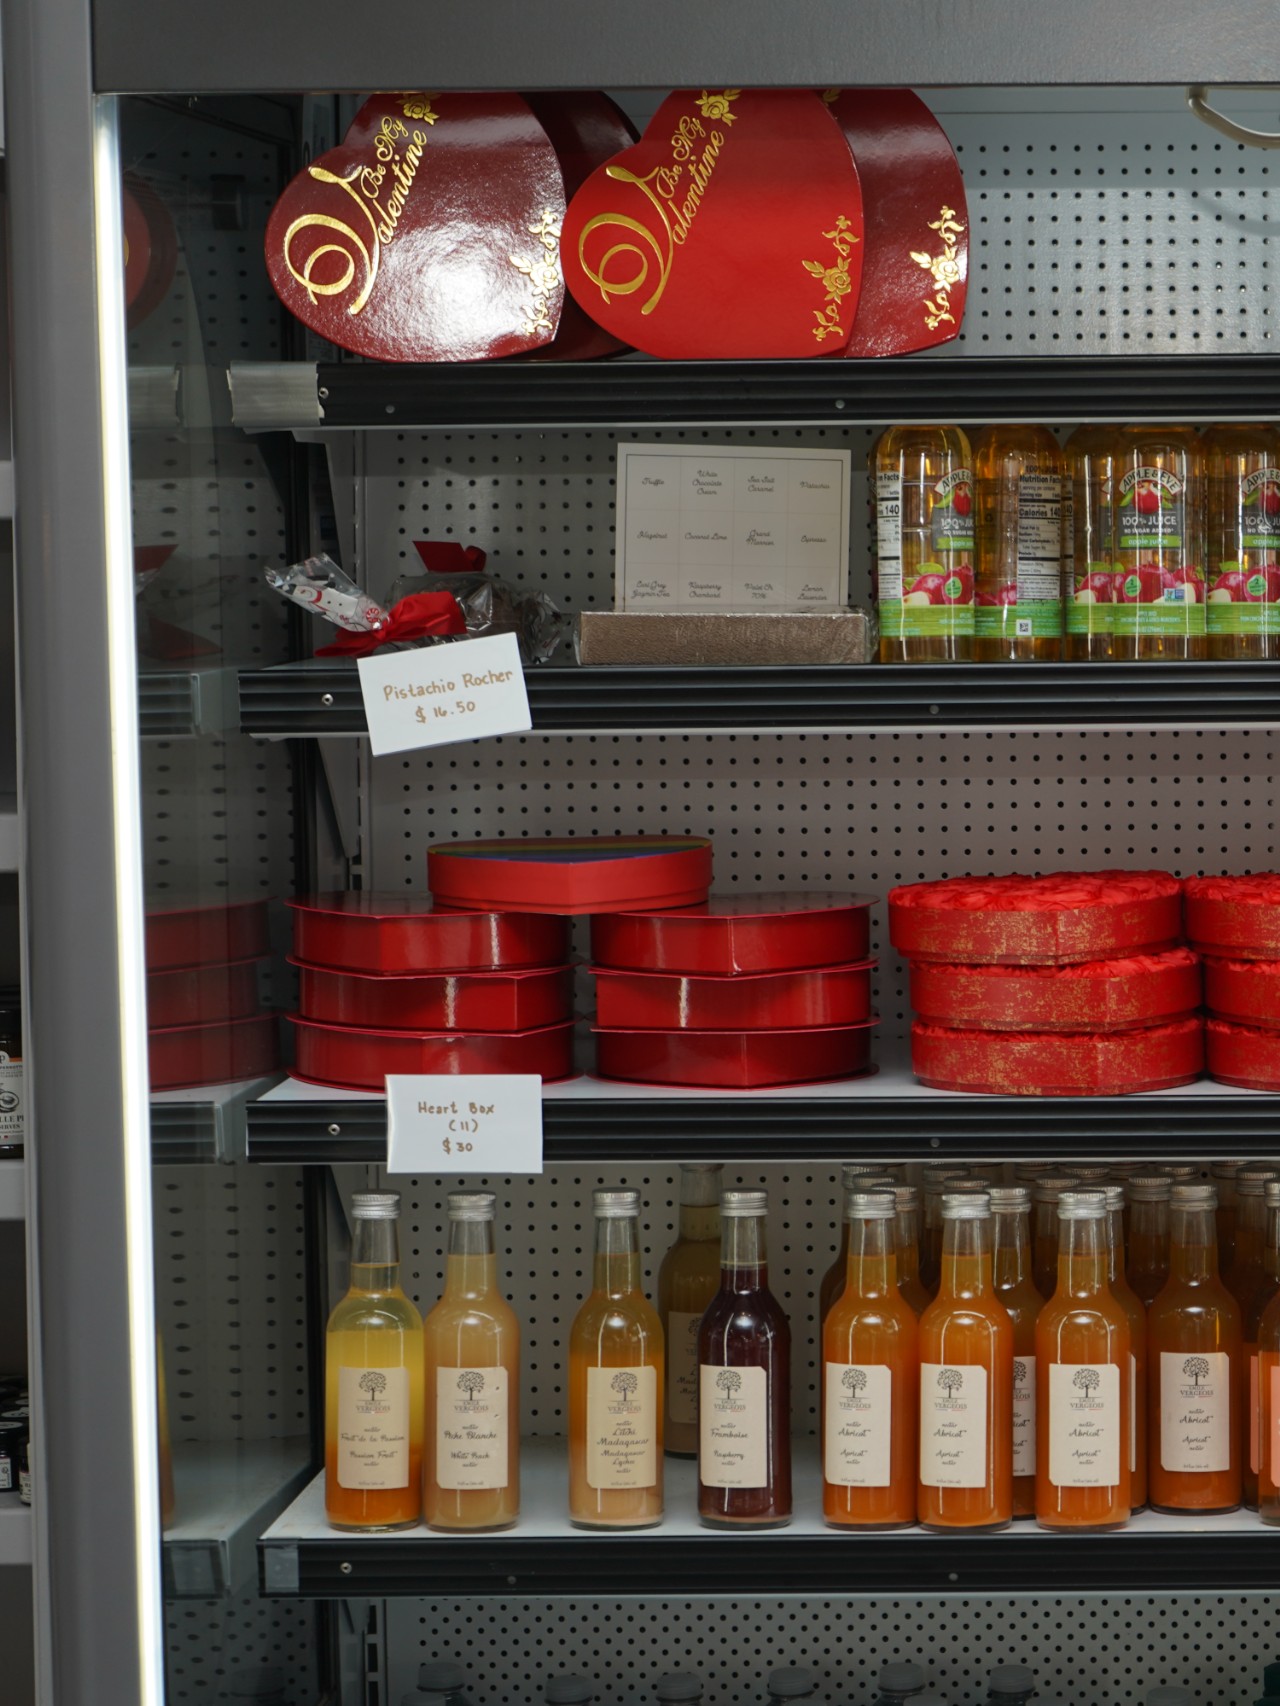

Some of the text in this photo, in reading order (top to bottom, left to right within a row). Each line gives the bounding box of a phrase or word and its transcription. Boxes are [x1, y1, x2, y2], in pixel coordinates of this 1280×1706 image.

[361, 116, 409, 199] Be My
[656, 115, 707, 199] Be My
[1123, 470, 1150, 492] APPLE
[885, 504, 900, 514] 140
[1019, 508, 1048, 516] Calories
[1148, 516, 1176, 525] JUICE
[383, 670, 513, 701] Pistachio Rocher
[418, 1102, 494, 1115] Heart Box
[449, 1119, 478, 1132] (11)
[456, 1142, 473, 1152] 30
[1179, 1415, 1214, 1424] Abricot
[467, 1431, 497, 1440] Blanche
[838, 1429, 872, 1438] Abricot
[933, 1429, 967, 1438] Abricot
[1069, 1429, 1104, 1438] Abricot
